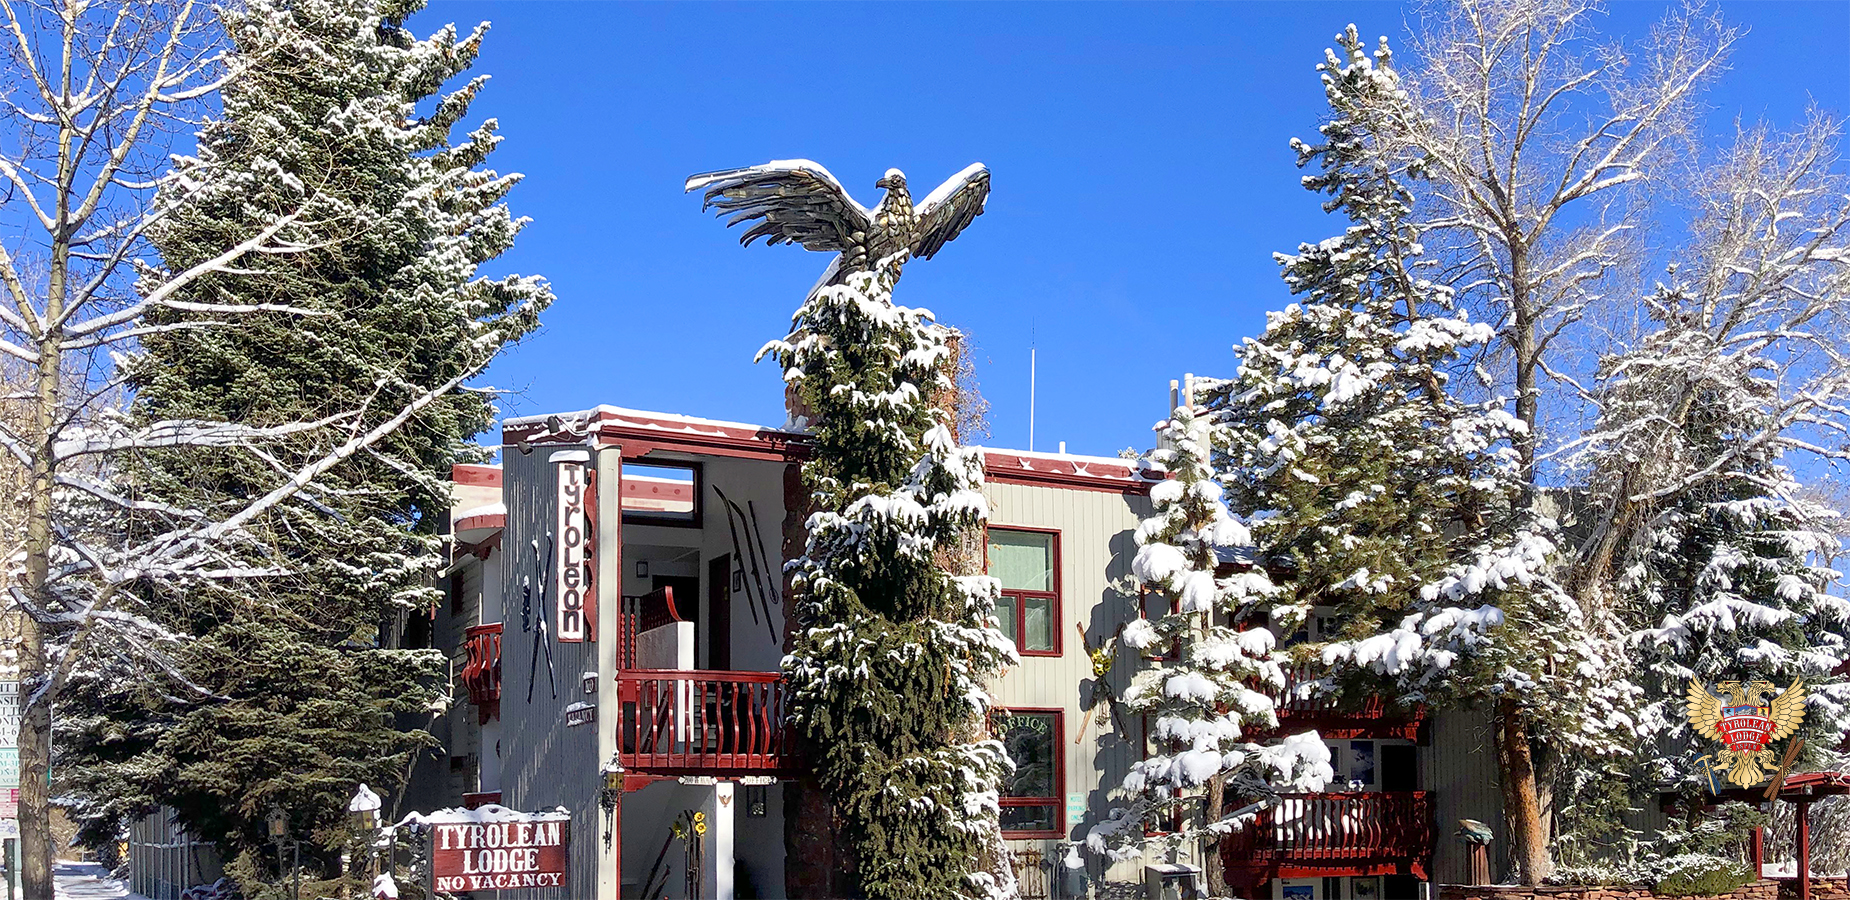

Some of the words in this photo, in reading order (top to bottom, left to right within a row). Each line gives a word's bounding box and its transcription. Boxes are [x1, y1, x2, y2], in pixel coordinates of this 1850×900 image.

[998, 715, 1048, 735] OFFICE
[437, 822, 561, 850] TYROLEAN
[462, 848, 540, 874] LODGE
[436, 876, 466, 891] NO
[469, 872, 562, 889] VACANCY
